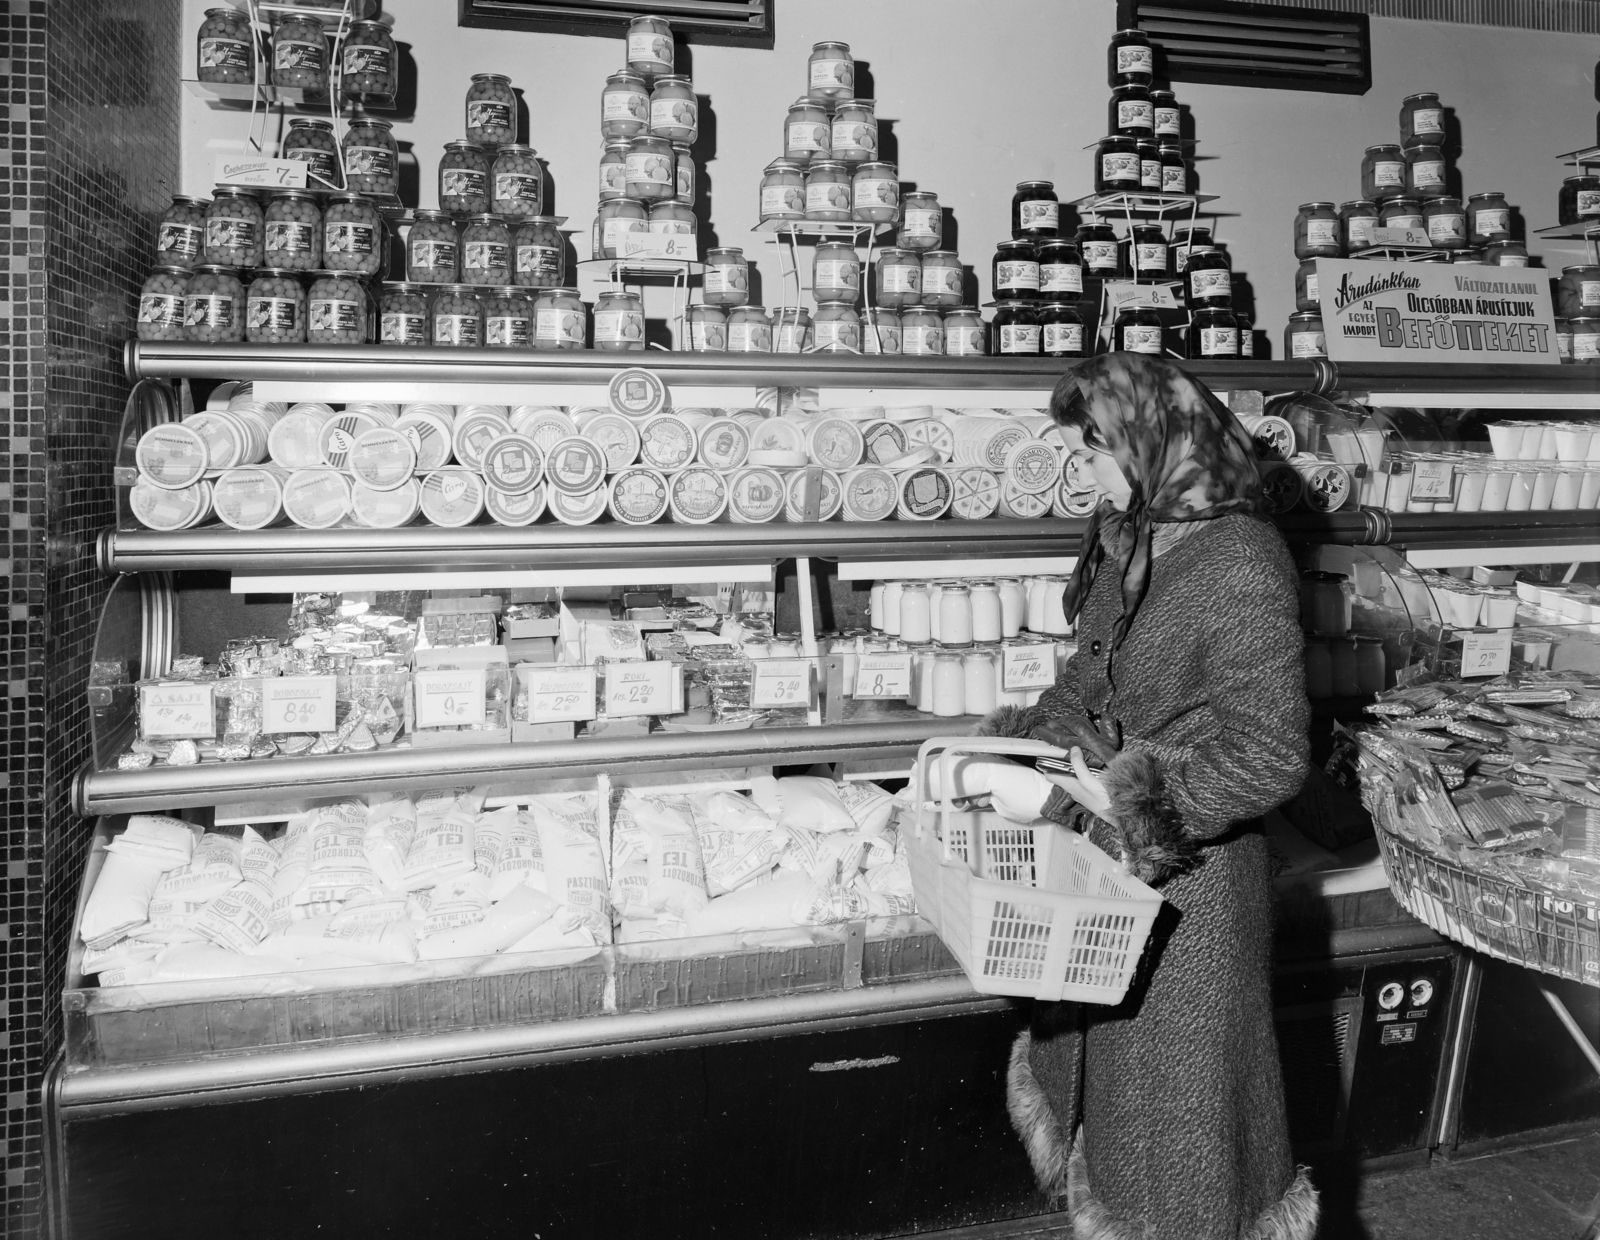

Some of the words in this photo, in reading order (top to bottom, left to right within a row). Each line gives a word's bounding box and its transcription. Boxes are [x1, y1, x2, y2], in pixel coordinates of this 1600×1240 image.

[1334, 271, 1421, 309] Árudánkban
[1454, 275, 1539, 295] VÁLTOZATLANUL
[1363, 301, 1374, 311] AZ
[1407, 293, 1474, 315] OLCSÓBBAN
[1475, 297, 1535, 317] ÁRUSÍTJUK
[1348, 313, 1376, 323] EGYES
[1343, 325, 1377, 336] IMPORT
[1375, 307, 1549, 353] BEFŐTTEKET
[154, 432, 195, 442] BUDAPEST
[334, 431, 348, 451] Caro
[444, 481, 465, 494] Caro
[1015, 652, 1035, 660] KEFIR
[623, 672, 646, 681] ROKI
[426, 681, 473, 692] DOBOZSAJT
[273, 687, 323, 698] DOBOZSAJT
[662, 851, 688, 868] TEJ
